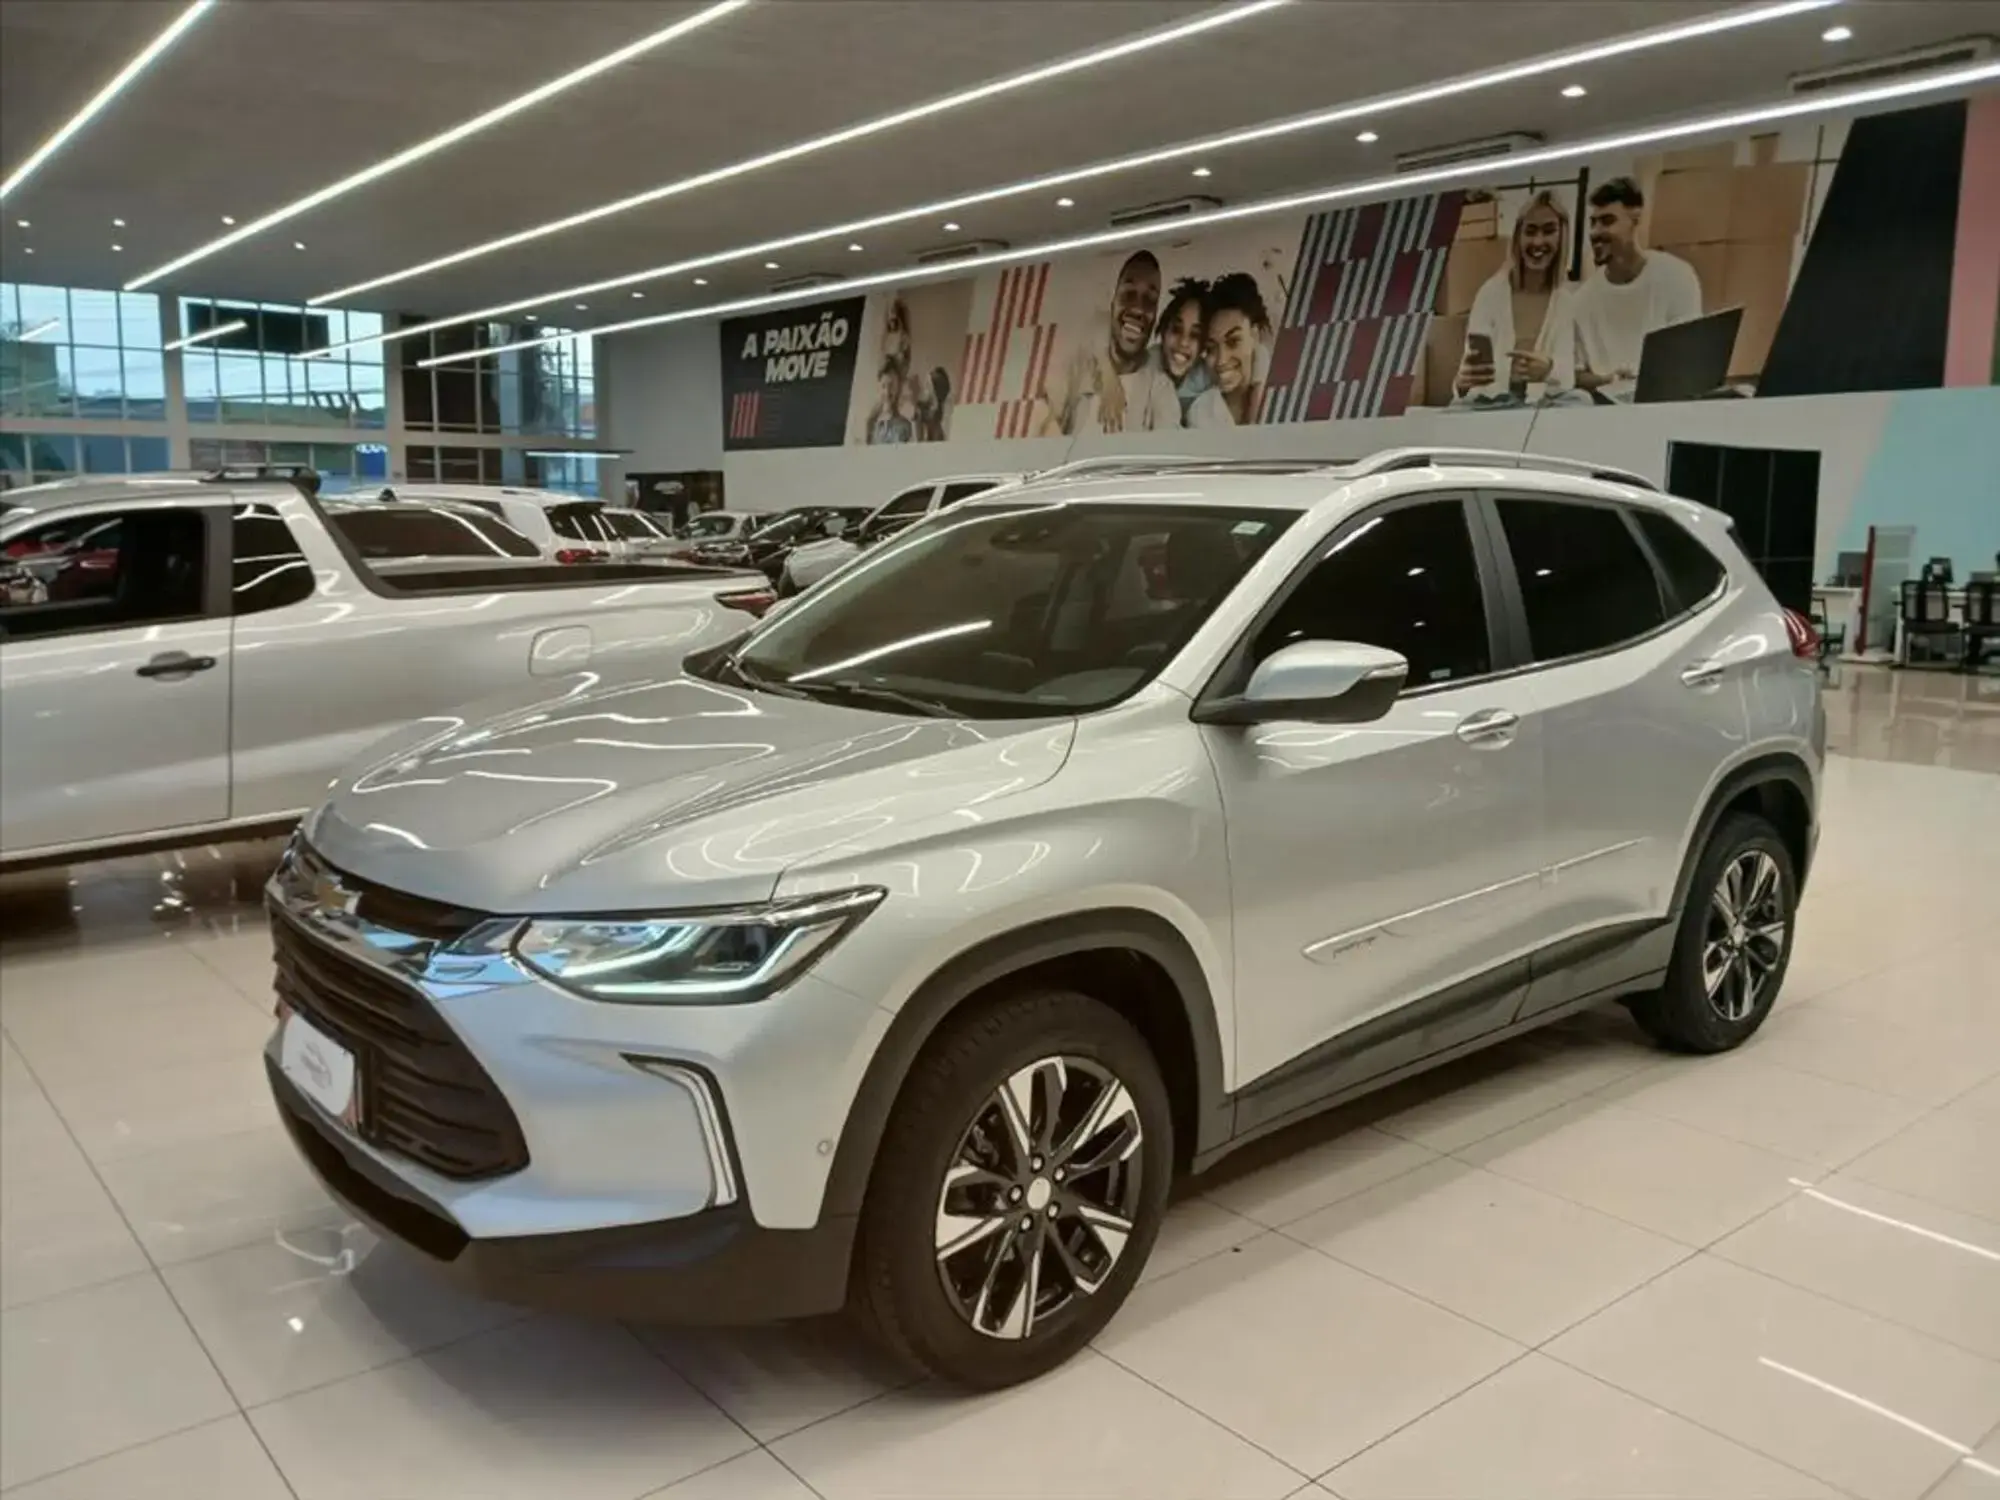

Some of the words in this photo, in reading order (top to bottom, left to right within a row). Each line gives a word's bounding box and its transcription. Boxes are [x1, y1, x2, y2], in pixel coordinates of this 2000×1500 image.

[741, 332, 758, 359] A
[763, 311, 849, 355] PAIXÃO
[765, 351, 831, 384] MOVE
